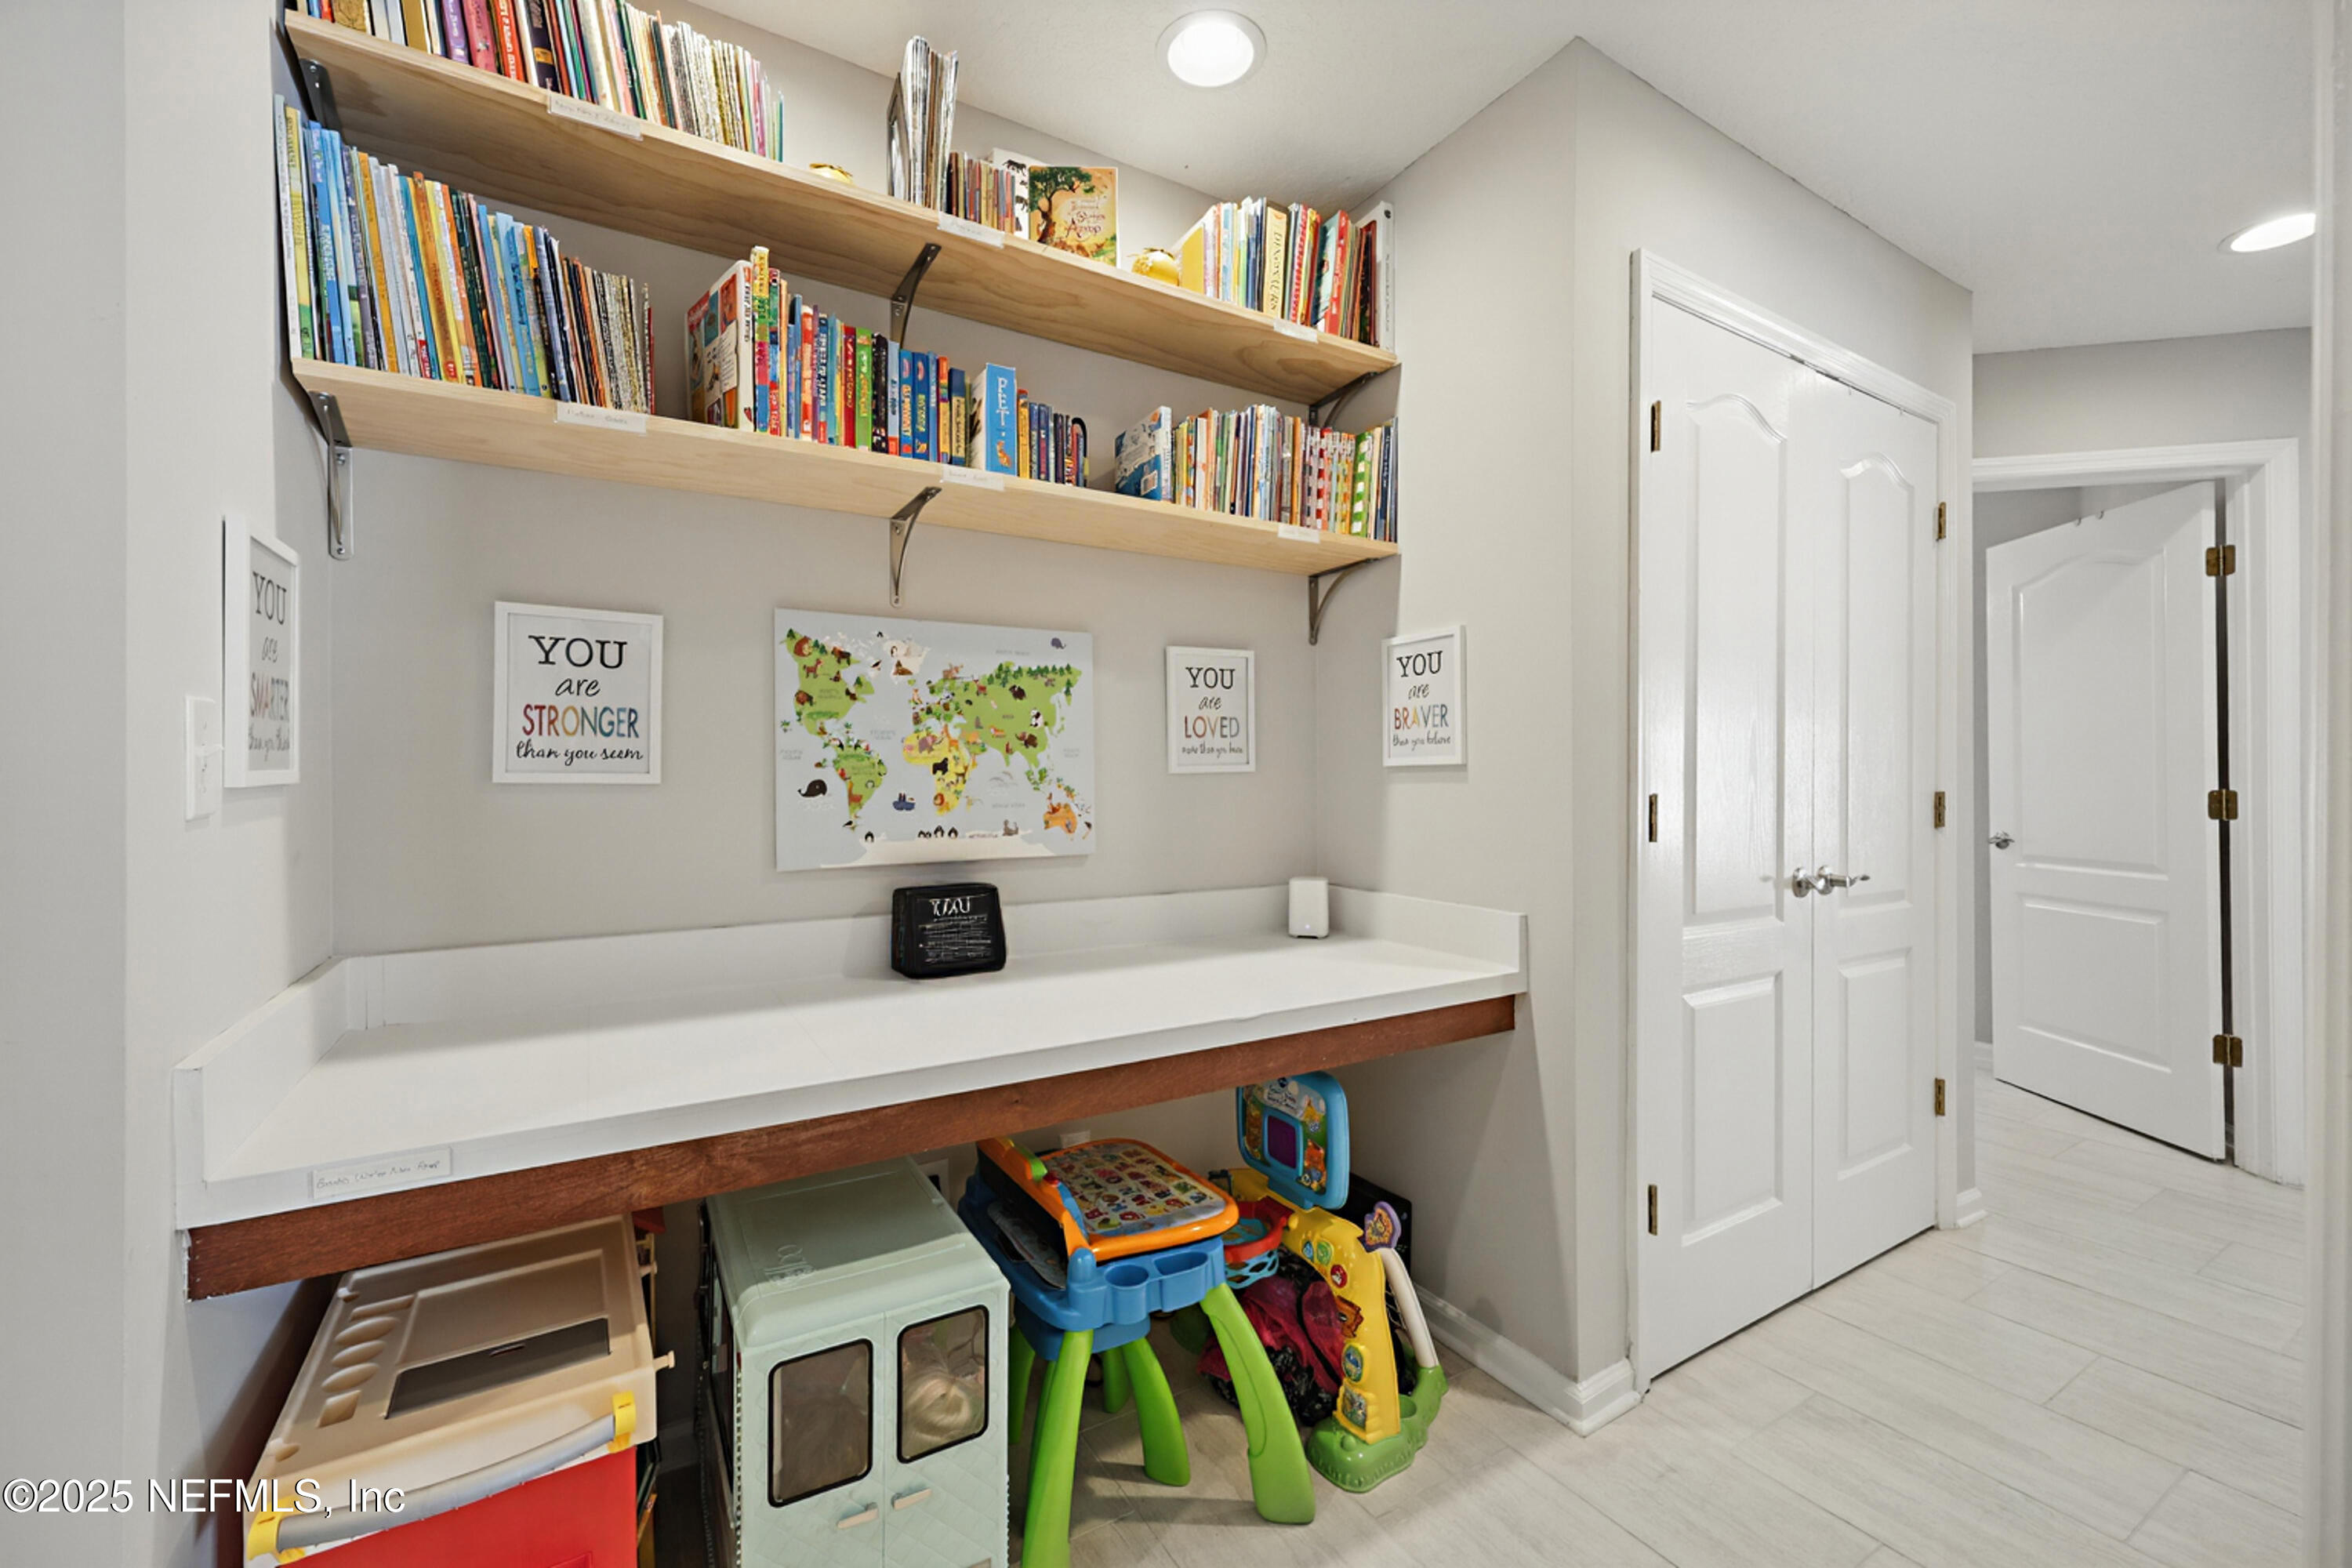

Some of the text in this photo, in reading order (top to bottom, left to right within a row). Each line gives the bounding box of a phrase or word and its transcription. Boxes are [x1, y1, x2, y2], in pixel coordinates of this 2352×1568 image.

[996, 376, 1010, 427] PET
[252, 571, 287, 626] YOU
[528, 635, 627, 669] YOU
[1396, 650, 1443, 677] YOU
[555, 677, 601, 697] are
[1185, 666, 1236, 690] YOU
[1408, 683, 1429, 700] are
[250, 672, 289, 722] SMARTER
[1198, 695, 1222, 710] are
[522, 703, 640, 739] STRONGER
[1184, 715, 1240, 739] LOVED
[1394, 703, 1449, 731] BRAVER
[517, 739, 644, 766] than you seem
